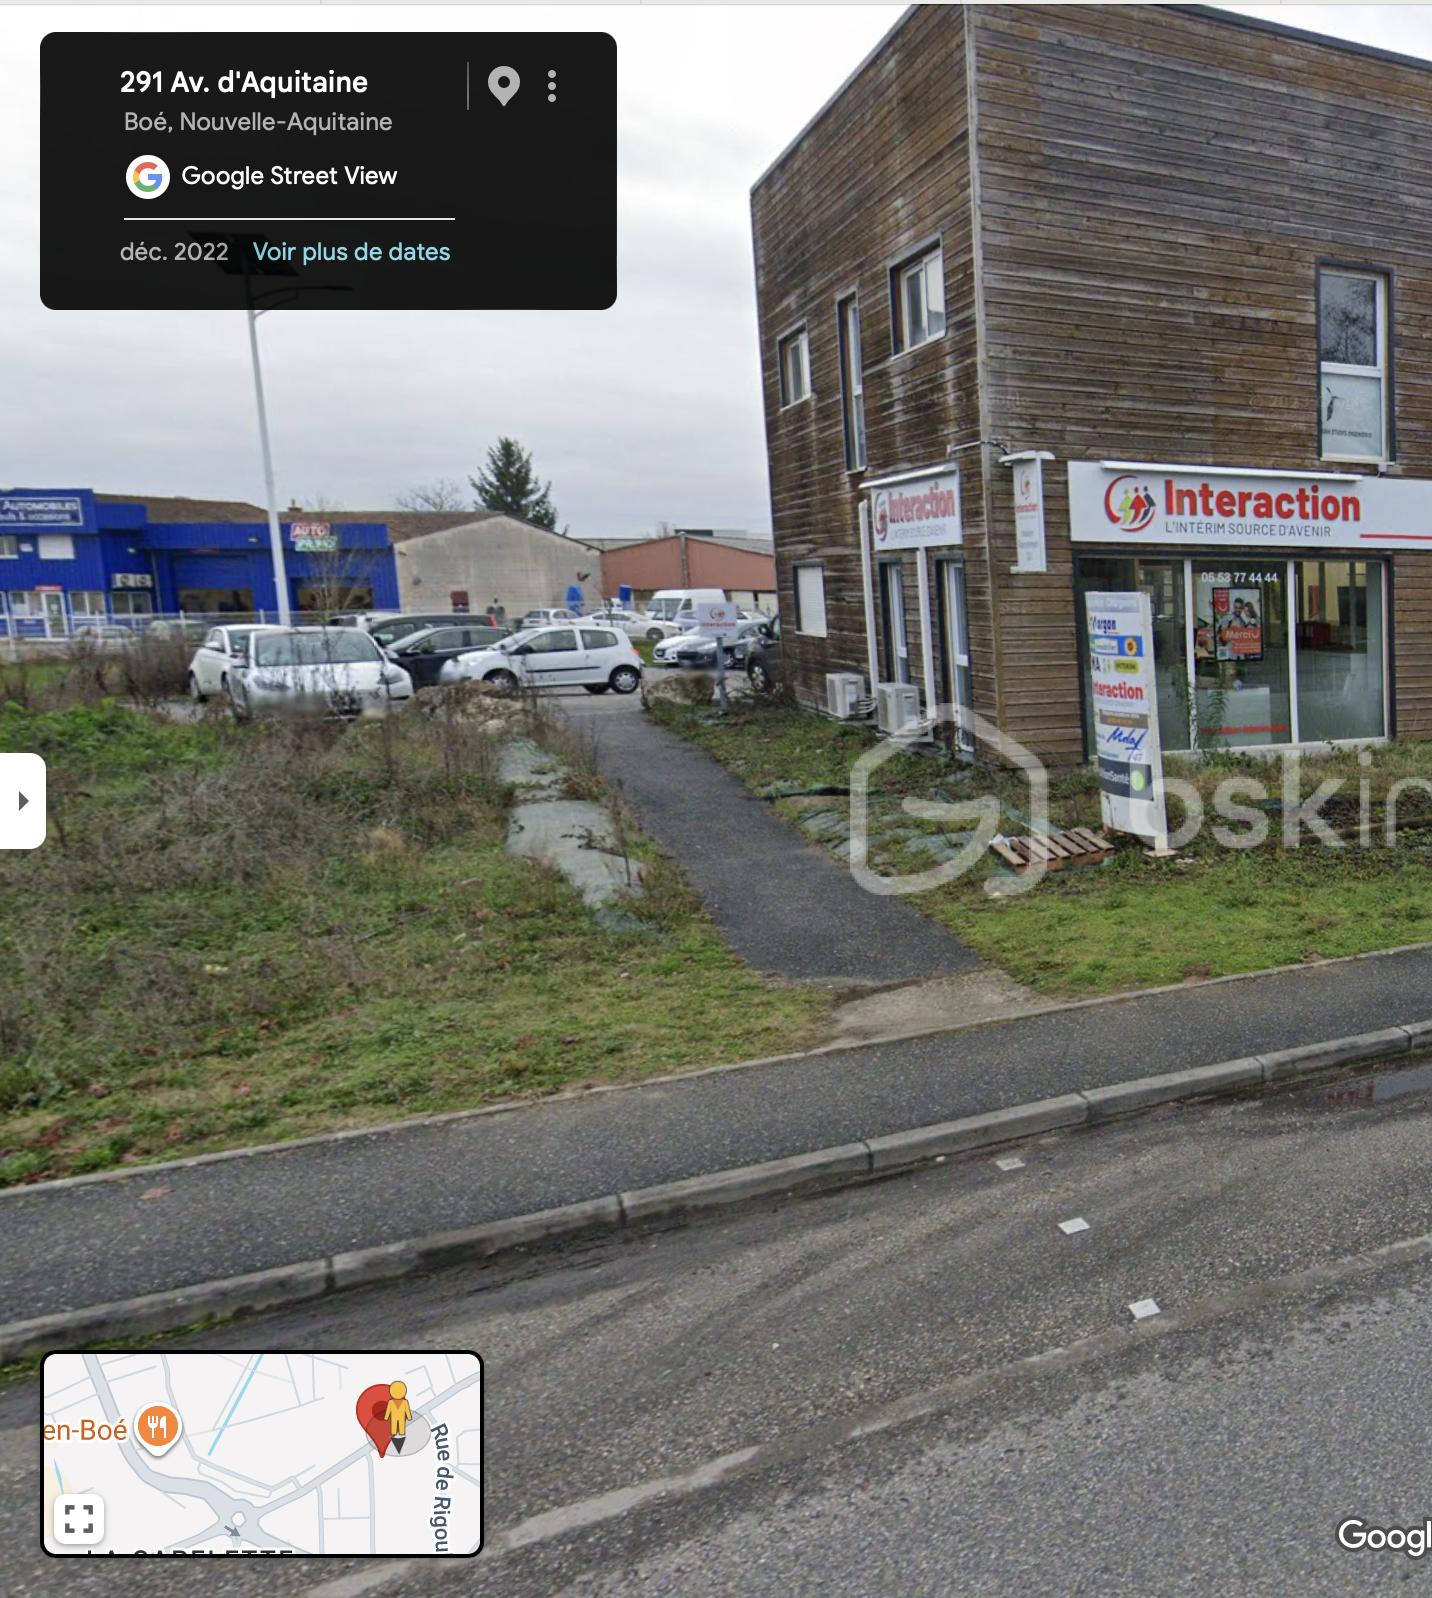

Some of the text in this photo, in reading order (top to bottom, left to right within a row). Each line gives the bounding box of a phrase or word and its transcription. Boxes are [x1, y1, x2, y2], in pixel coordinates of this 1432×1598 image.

[888, 481, 956, 524] Interaction
[1164, 479, 1361, 522] Interaction
[1228, 522, 1276, 536] SOURCE
[1279, 524, 1331, 537] D'AVENIR
[1201, 572, 1277, 583] 05 53 77 44 44
